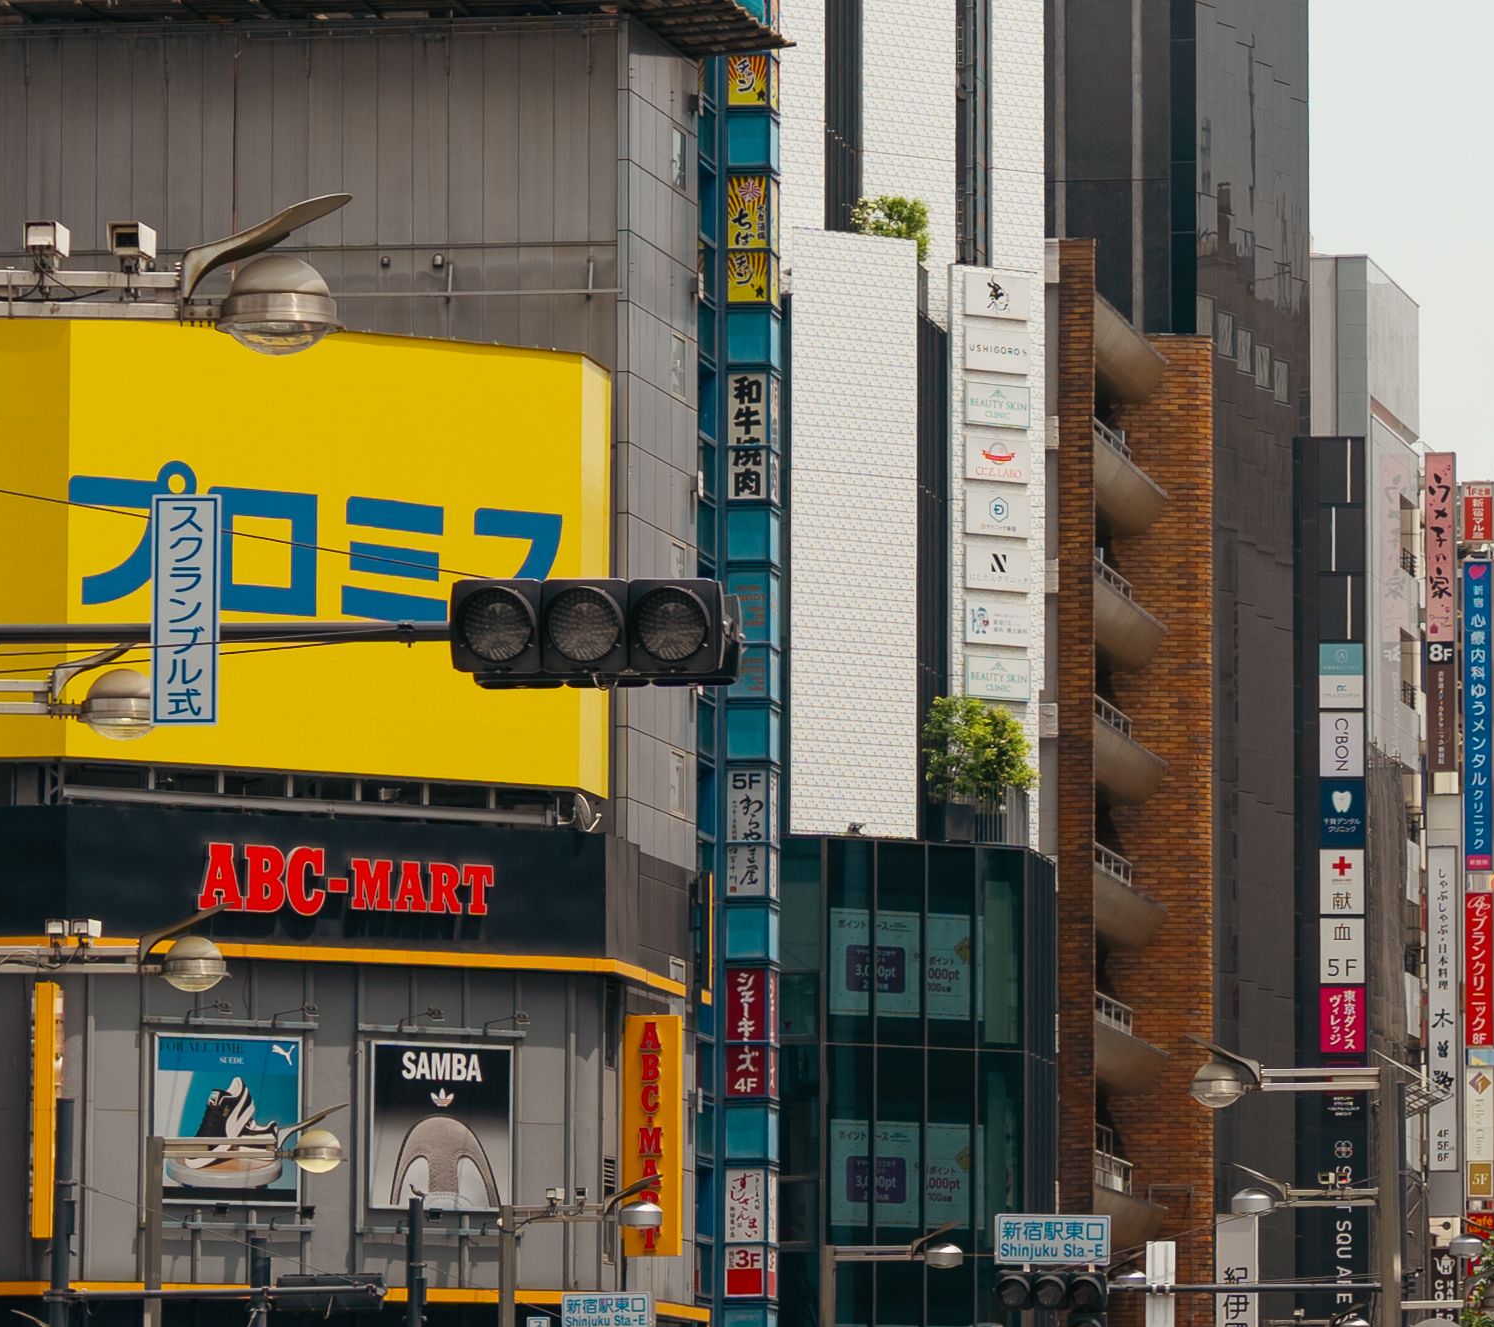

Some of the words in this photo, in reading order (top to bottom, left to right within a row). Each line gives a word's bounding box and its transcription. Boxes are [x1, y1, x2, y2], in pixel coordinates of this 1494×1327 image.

[970, 344, 1019, 357] USHIGORO
[970, 398, 1003, 410] BEAUTY
[1006, 401, 1027, 412] SKIN
[985, 409, 1010, 420] CLINIC
[732, 376, 762, 497] 和牛焼肉
[68, 460, 562, 622] プロミス
[1472, 584, 1484, 609] 新宿
[167, 506, 204, 717] スクランブル式
[1429, 644, 1453, 662] 8F
[970, 671, 1004, 682] BEAUTY
[1007, 673, 1027, 684] SKIN
[985, 683, 1011, 693] CLINIC
[1471, 612, 1487, 852] 心療内科ゆうメンタルクリニック
[732, 774, 761, 790] 5F
[1328, 826, 1357, 834] クリニック
[198, 843, 494, 917] ABC-MART
[1437, 869, 1449, 990] しゃぶしゃぶ・日本料理
[1328, 958, 1357, 977] 5F
[1471, 916, 1487, 1031] ブランクリニック
[736, 972, 758, 1073] シェーキーズ
[1329, 994, 1342, 1046] ヴィレッジ
[1343, 990, 1356, 1050] 東京ダンス
[159, 1041, 186, 1054] FOR
[189, 1041, 213, 1054] ALL
[215, 1041, 244, 1054] TIME
[1472, 1033, 1487, 1045] 8F
[219, 1056, 244, 1065] SUEDE
[401, 1051, 483, 1083] SAMBA
[734, 1077, 757, 1093] 4F
[637, 1022, 664, 1252] ABC-MAT
[1436, 1130, 1449, 1138] 4F
[1436, 1142, 1449, 1150] 5F
[1436, 1153, 1449, 1162] 6F
[1471, 1173, 1488, 1185] 5F
[1002, 1222, 1104, 1241] 新宿駅東口
[735, 1249, 762, 1269] 3F
[1001, 1241, 1059, 1259] Shinjuku
[1063, 1241, 1103, 1259] Sta.-E
[565, 1297, 647, 1315] 新宿駅東口
[613, 1315, 646, 1327] Sta.-E
